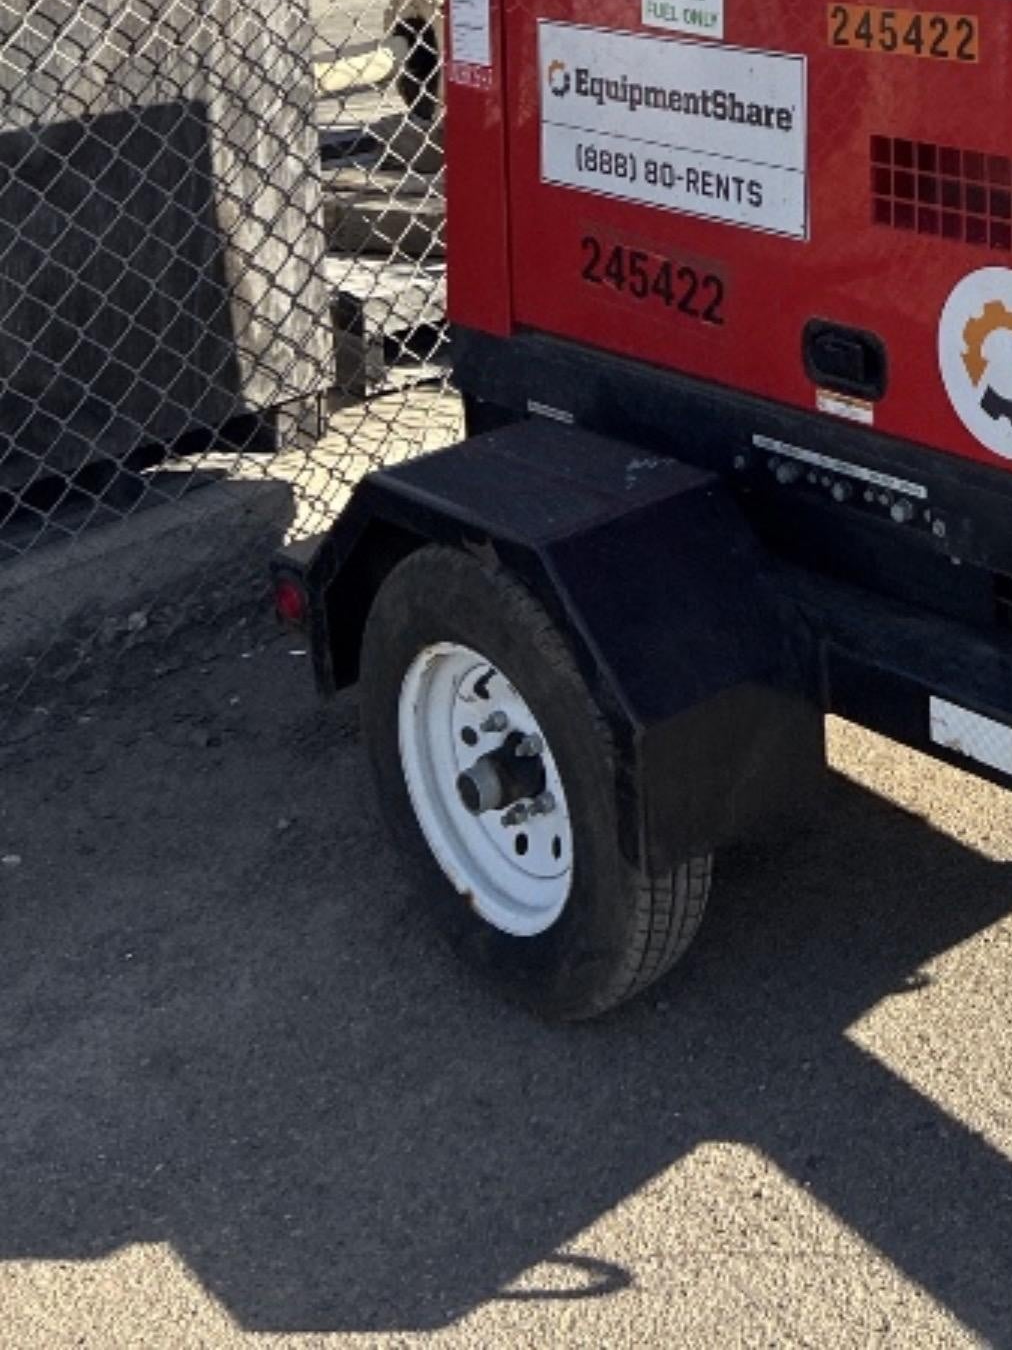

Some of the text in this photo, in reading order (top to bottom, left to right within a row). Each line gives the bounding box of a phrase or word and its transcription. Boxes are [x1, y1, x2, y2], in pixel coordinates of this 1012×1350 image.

[645, 0, 679, 22] FUEL
[830, 5, 976, 62] 245422
[575, 67, 793, 132] EquipmentShare
[575, 143, 763, 208] (888) 80-RENTS
[580, 235, 726, 326] 245422
